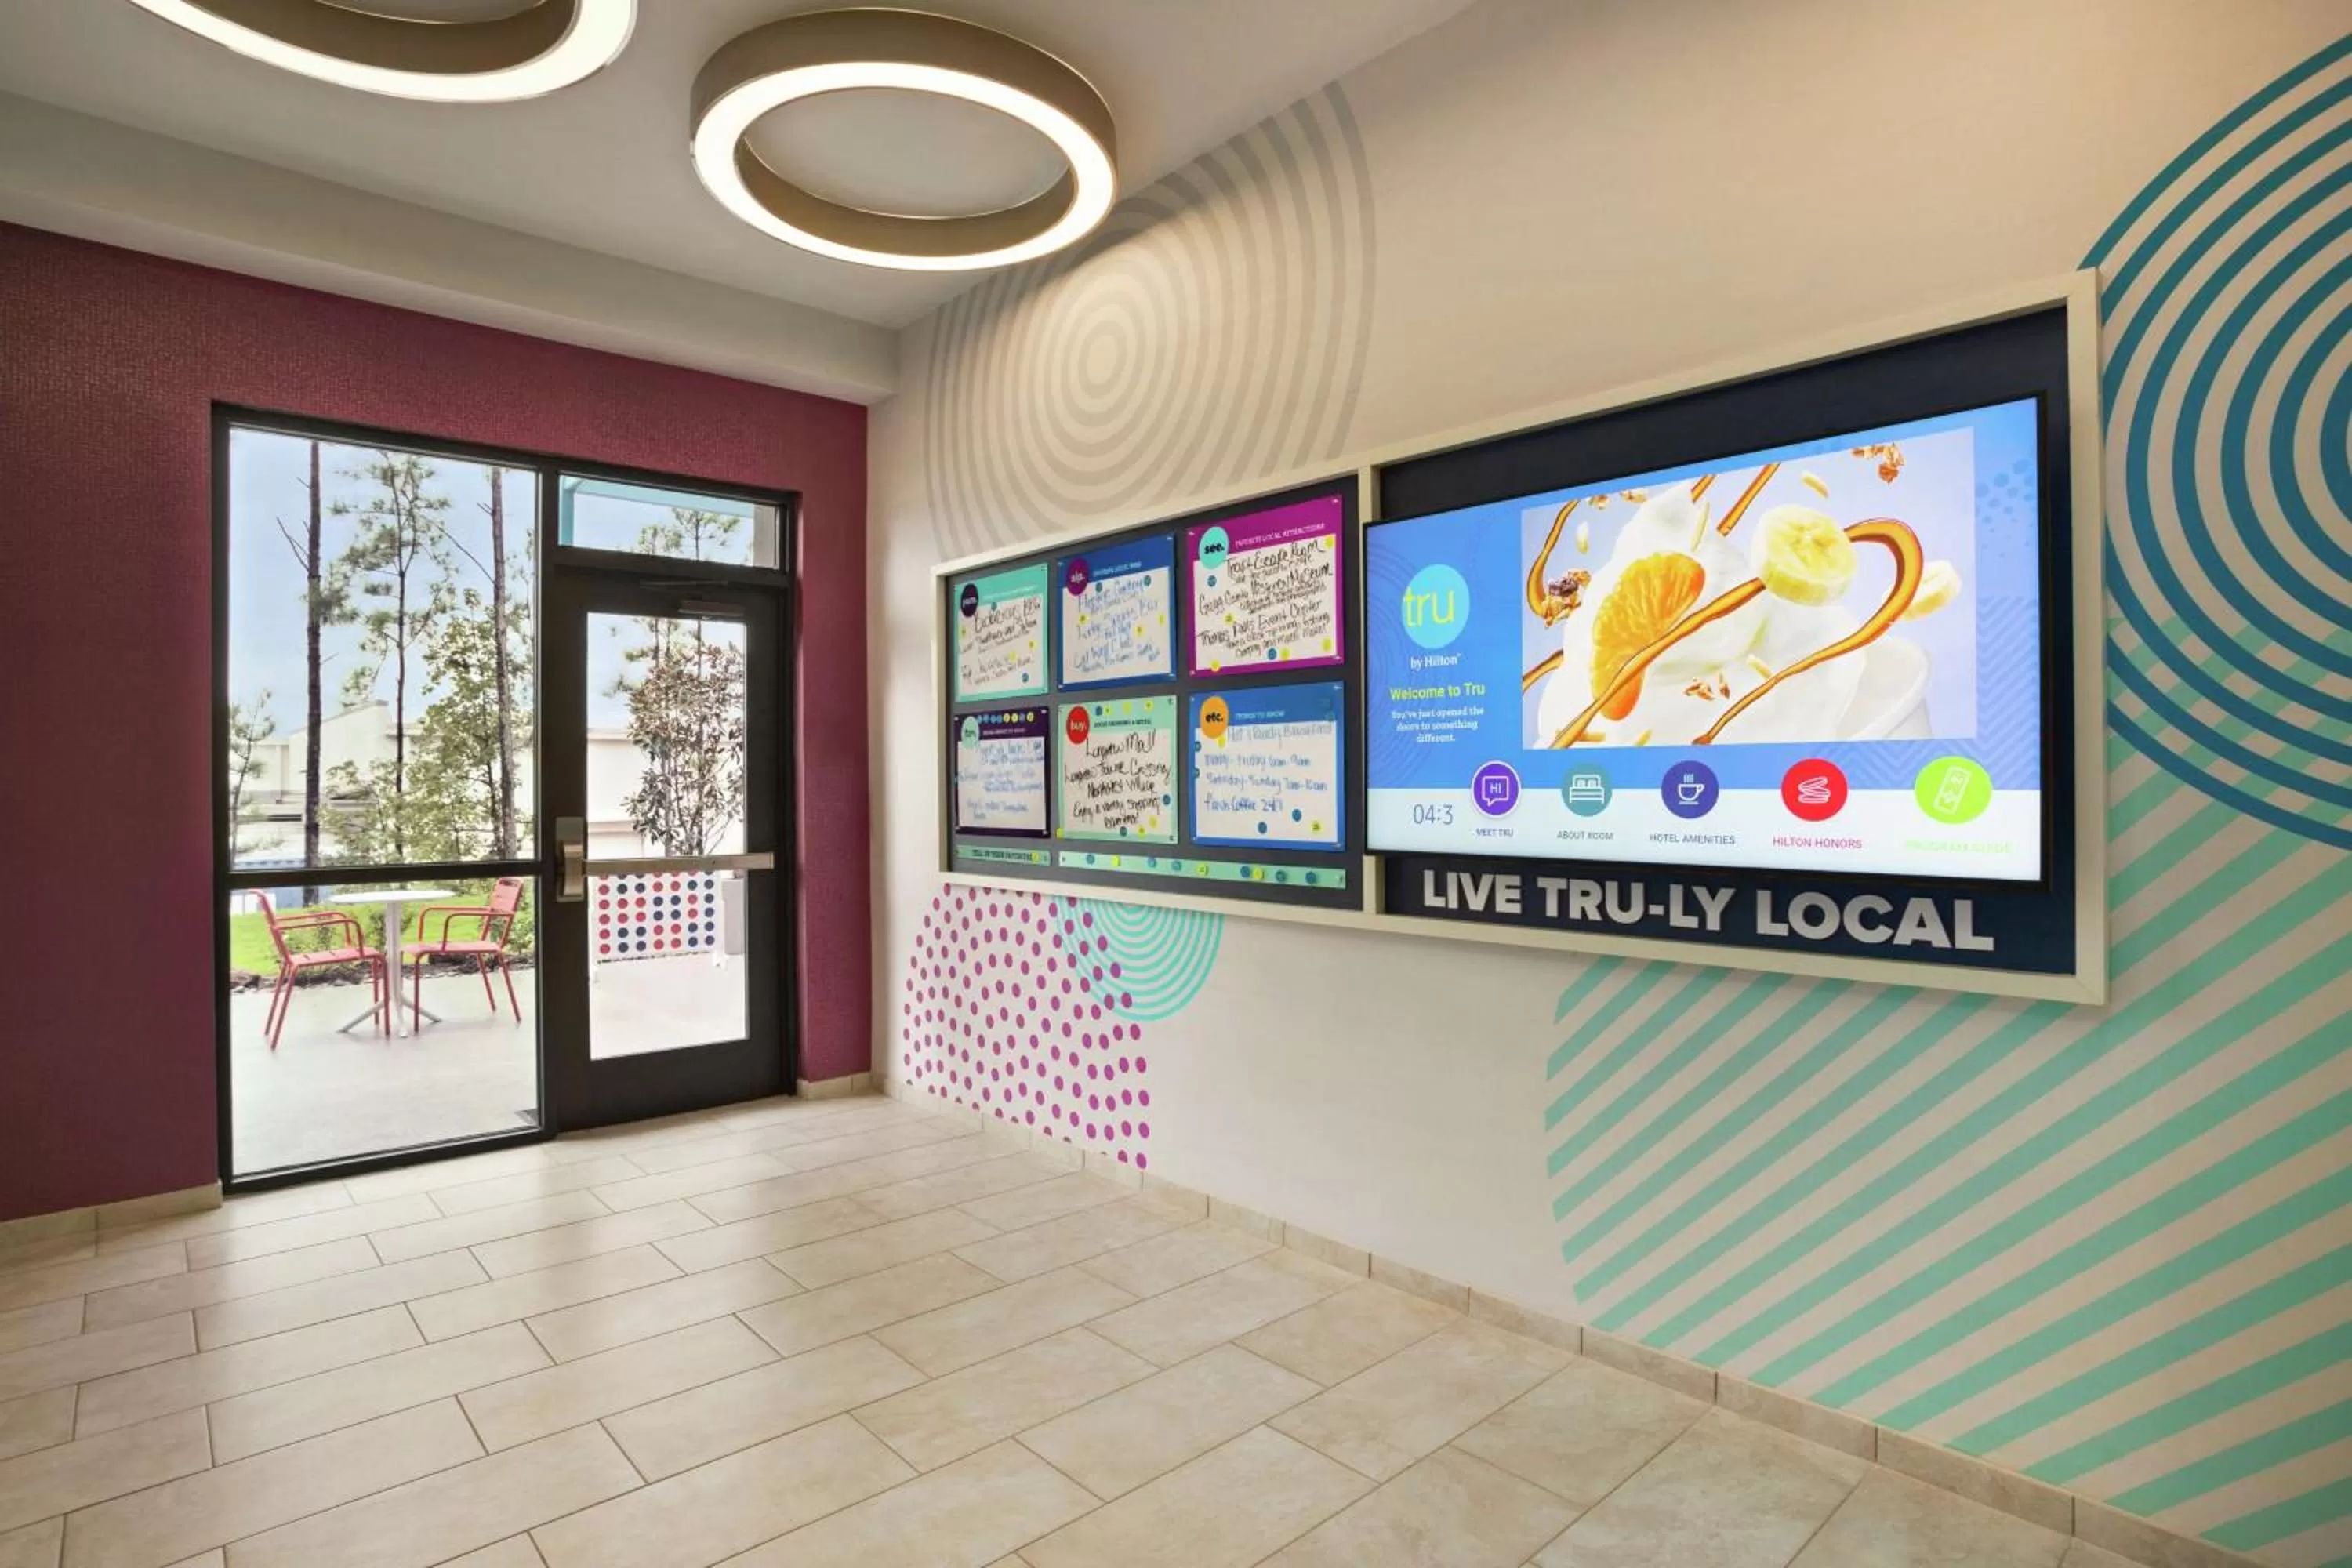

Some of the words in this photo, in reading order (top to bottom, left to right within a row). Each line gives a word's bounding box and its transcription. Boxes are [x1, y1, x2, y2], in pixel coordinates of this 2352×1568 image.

[1204, 543, 1225, 554] see.
[1403, 586, 1455, 628] tru
[1410, 657, 1423, 671] by
[1390, 686, 1444, 701] Welcome
[1448, 684, 1460, 697] to
[1463, 683, 1486, 696] Tru
[1205, 712, 1224, 722] etc.
[1418, 708, 1436, 720] just
[1436, 706, 1468, 719] opened
[1469, 705, 1484, 716] the
[1069, 720, 1087, 732] buy.
[1421, 720, 1431, 731] to
[1432, 718, 1478, 731] something
[1490, 784, 1502, 795] HI
[1413, 804, 1454, 825] 04:3
[1475, 827, 1497, 837] MEET
[1498, 828, 1514, 837] TRU
[1556, 830, 1585, 840] ABOUT
[1588, 831, 1614, 840] ROOM
[1649, 833, 1679, 844] HOTEL
[1682, 834, 1736, 845] AMENITIES
[1772, 836, 1812, 848] HILTON
[1815, 837, 1863, 850] HONORS
[1422, 869, 1523, 915] LIVE
[1537, 877, 1737, 933] TRU-LY
[1755, 888, 1995, 952] LOCAL
